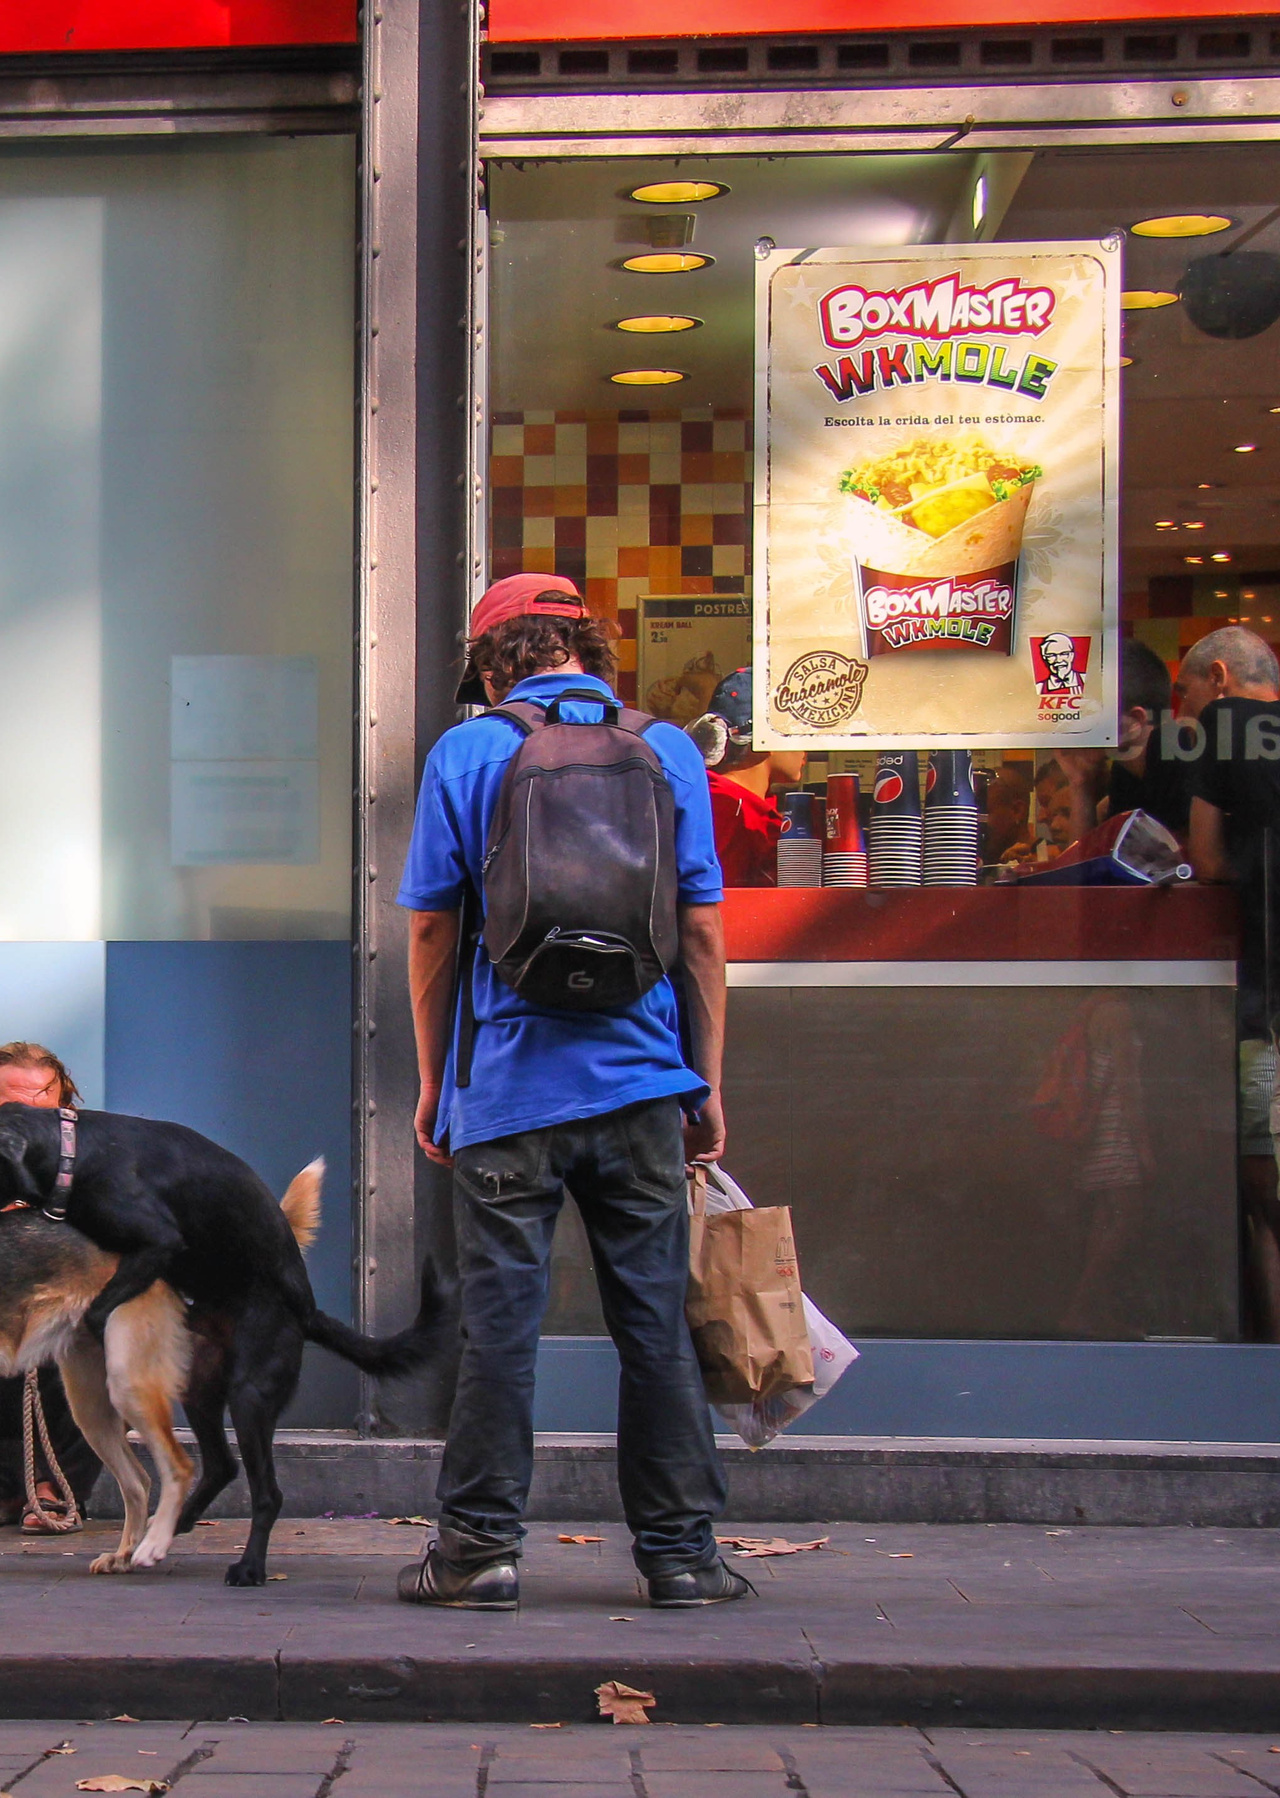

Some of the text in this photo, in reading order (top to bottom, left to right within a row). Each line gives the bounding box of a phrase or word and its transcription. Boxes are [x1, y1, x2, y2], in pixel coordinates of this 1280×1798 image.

[818, 340, 1059, 401] WKMOLE
[823, 412, 1046, 427] Escolta la crida del teu estòmac.
[694, 603, 750, 615] POSTRES
[883, 617, 996, 647] WKMOLE
[794, 657, 837, 682] SALSA
[779, 663, 862, 708] Guacamole
[796, 685, 856, 722] MEXICANA
[1037, 695, 1083, 710] KFC
[1037, 711, 1080, 723] sogood
